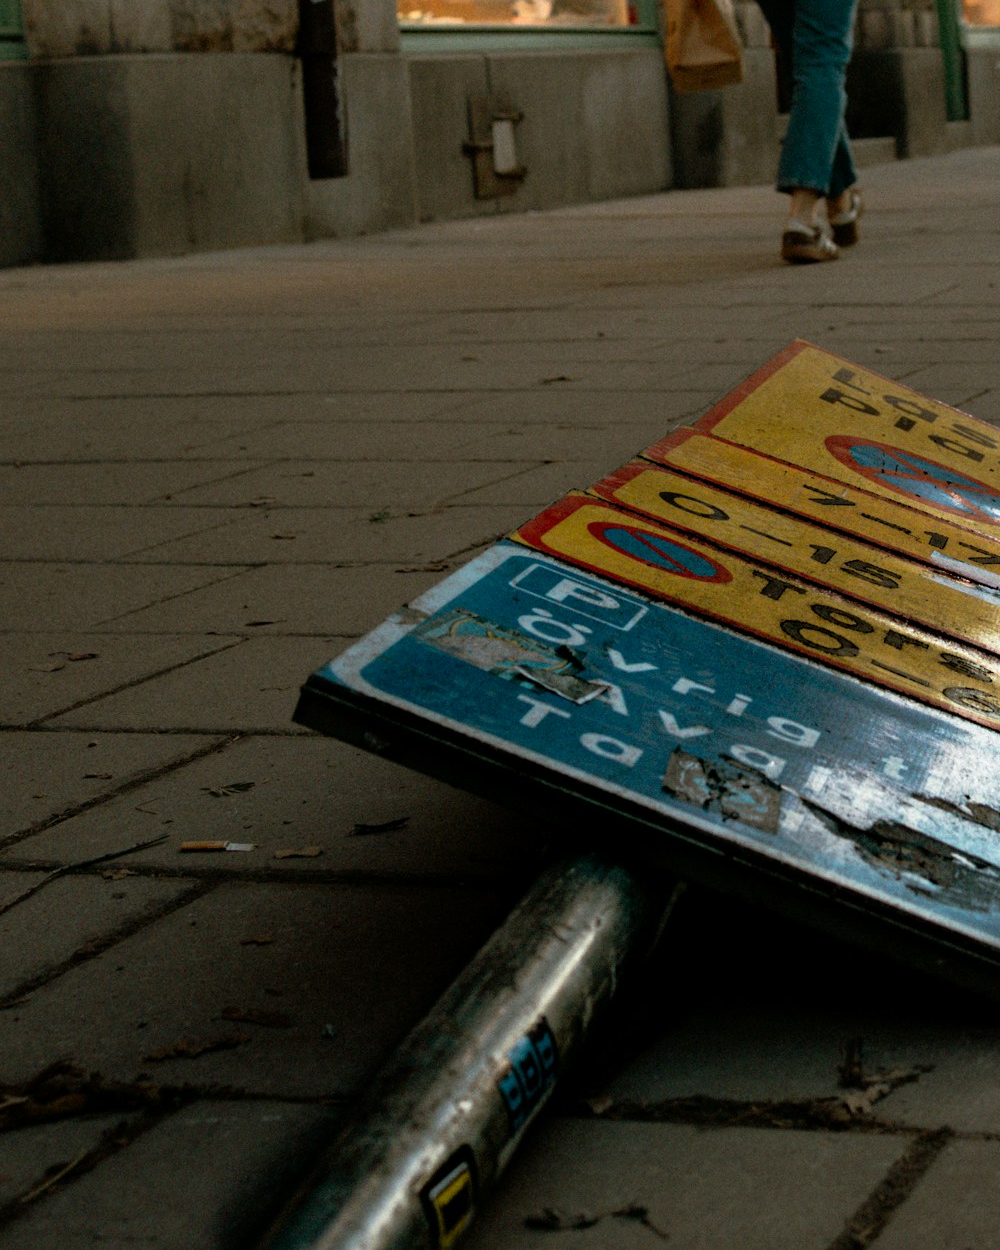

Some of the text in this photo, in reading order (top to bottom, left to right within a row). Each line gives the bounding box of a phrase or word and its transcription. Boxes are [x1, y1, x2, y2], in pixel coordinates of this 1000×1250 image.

[659, 491, 903, 589] 0-15
[546, 579, 621, 612] P
[518, 607, 821, 748] Övrig
